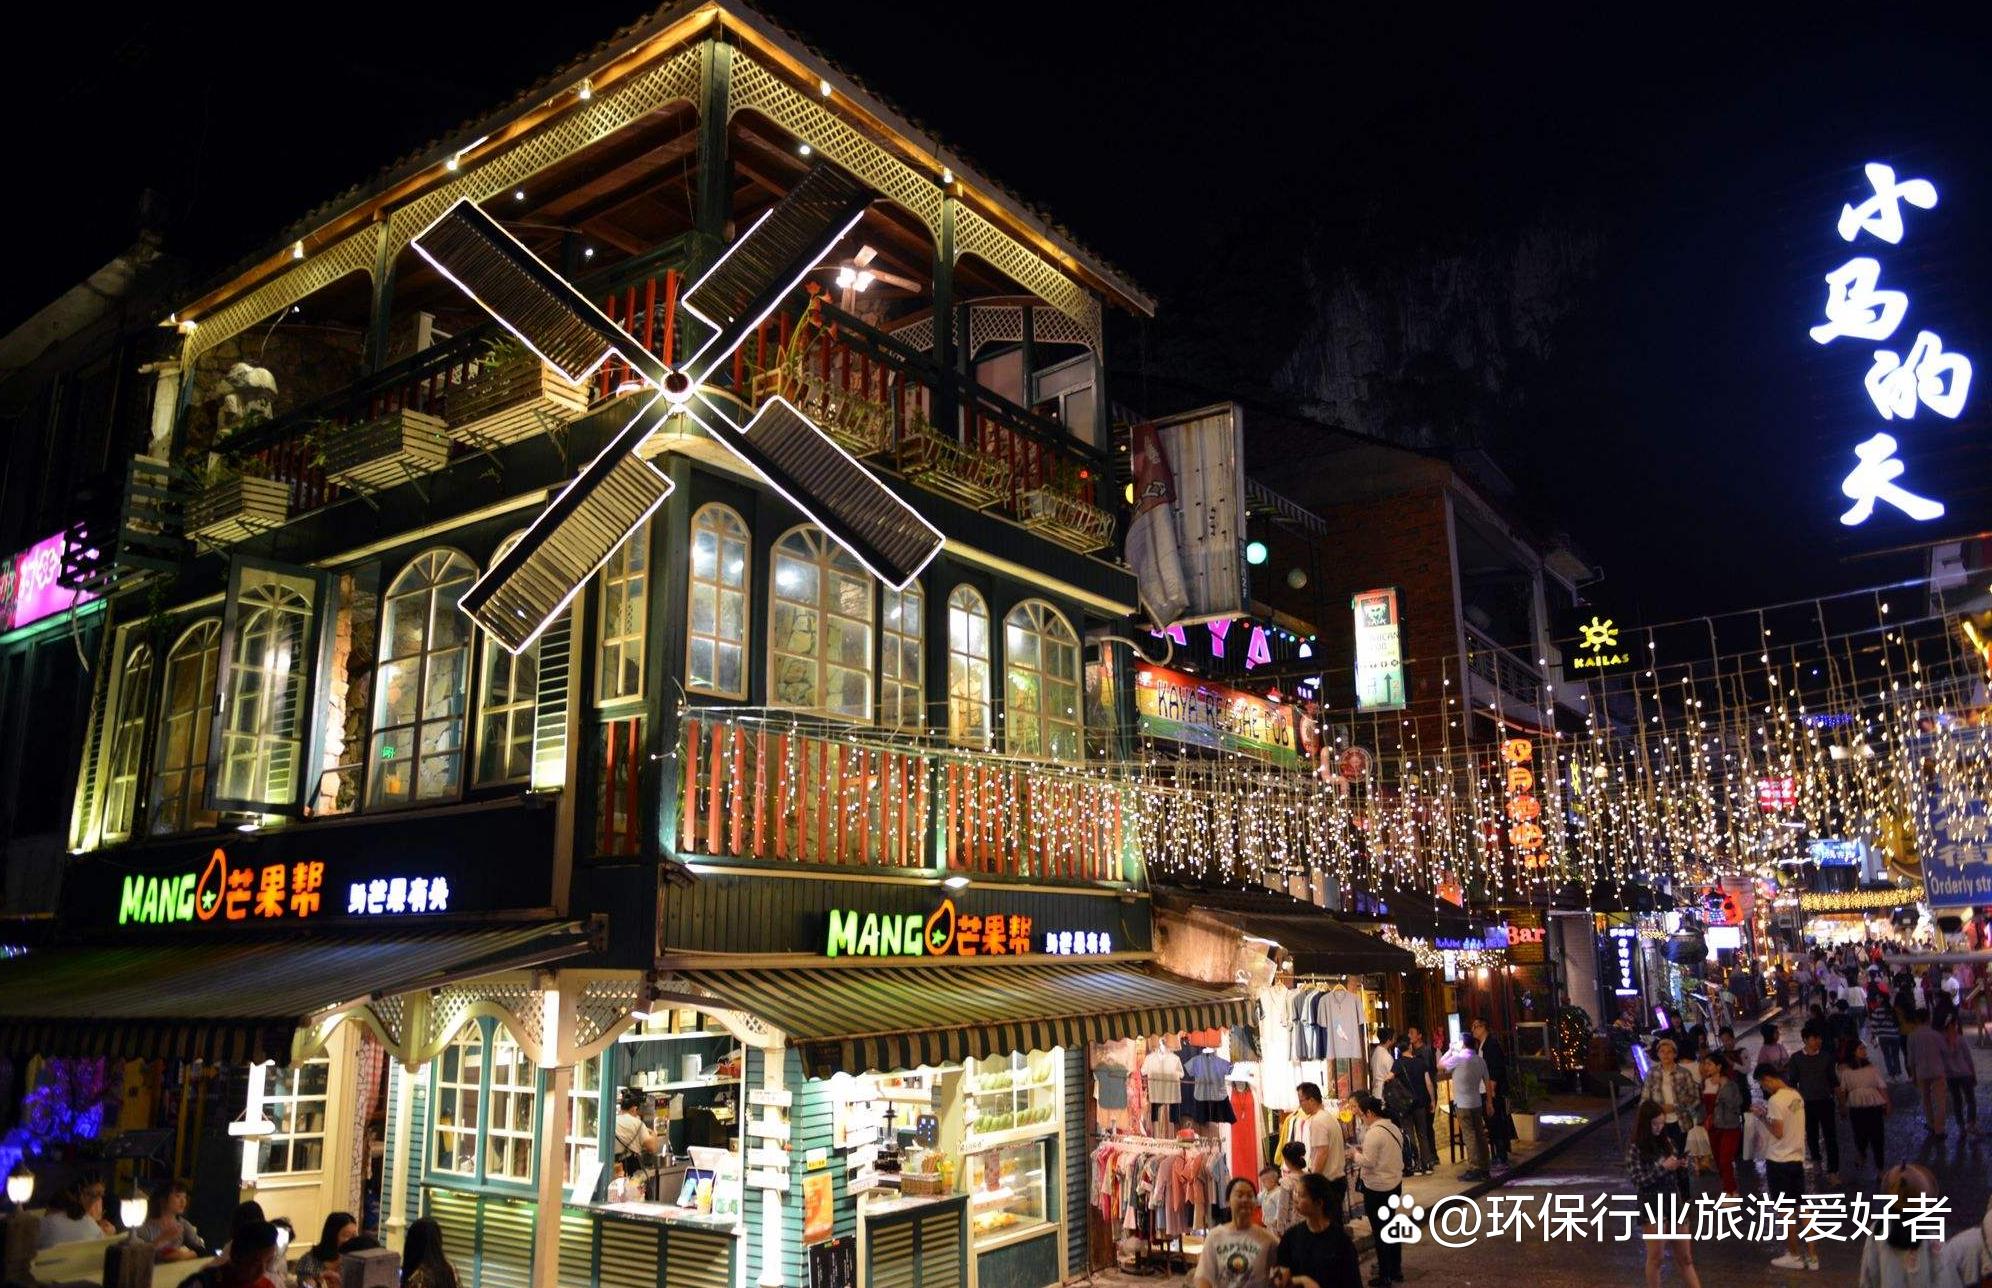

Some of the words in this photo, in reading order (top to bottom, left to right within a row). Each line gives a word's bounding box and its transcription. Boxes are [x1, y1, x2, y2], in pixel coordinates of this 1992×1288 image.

[1809, 162, 1973, 527] 小马的天
[1573, 653, 1630, 669] KAILAS
[1157, 680, 1198, 724] KAYA
[1264, 710, 1289, 746] PUB
[227, 861, 325, 920] 芒果帮
[1930, 874, 1974, 899] Orderly
[956, 913, 1033, 957] 芒果帮
[1506, 926, 1546, 945] Bar
